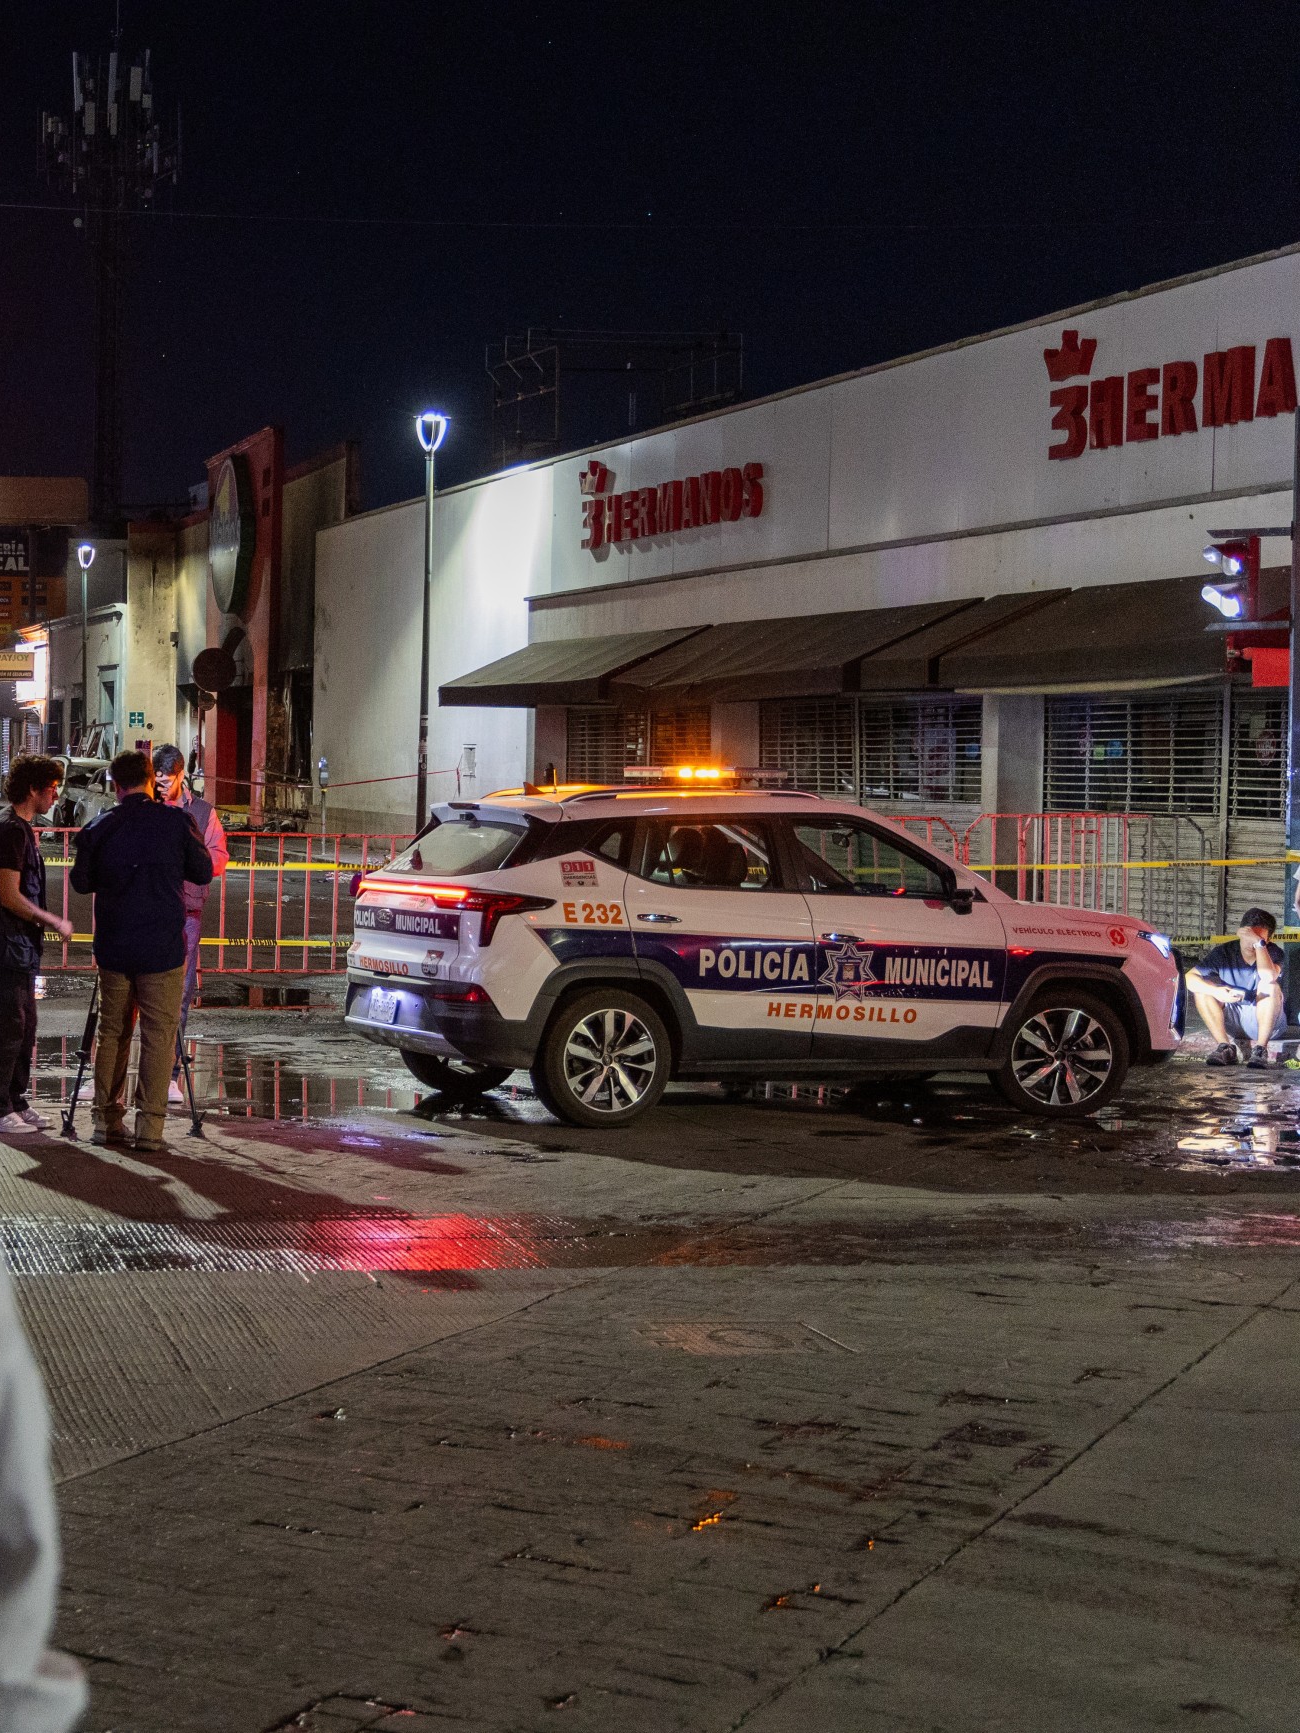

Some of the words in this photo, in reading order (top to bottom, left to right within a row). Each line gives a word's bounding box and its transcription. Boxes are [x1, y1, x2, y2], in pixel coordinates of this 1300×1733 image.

[563, 902, 578, 923] E
[582, 903, 623, 924] 232
[395, 914, 442, 934] MUNICIPAL
[360, 956, 409, 975] HERMOSILLO
[698, 947, 809, 981] POLICÍA
[884, 956, 994, 988] MUNICIPAL
[767, 1002, 918, 1023] HERMOSILLO
